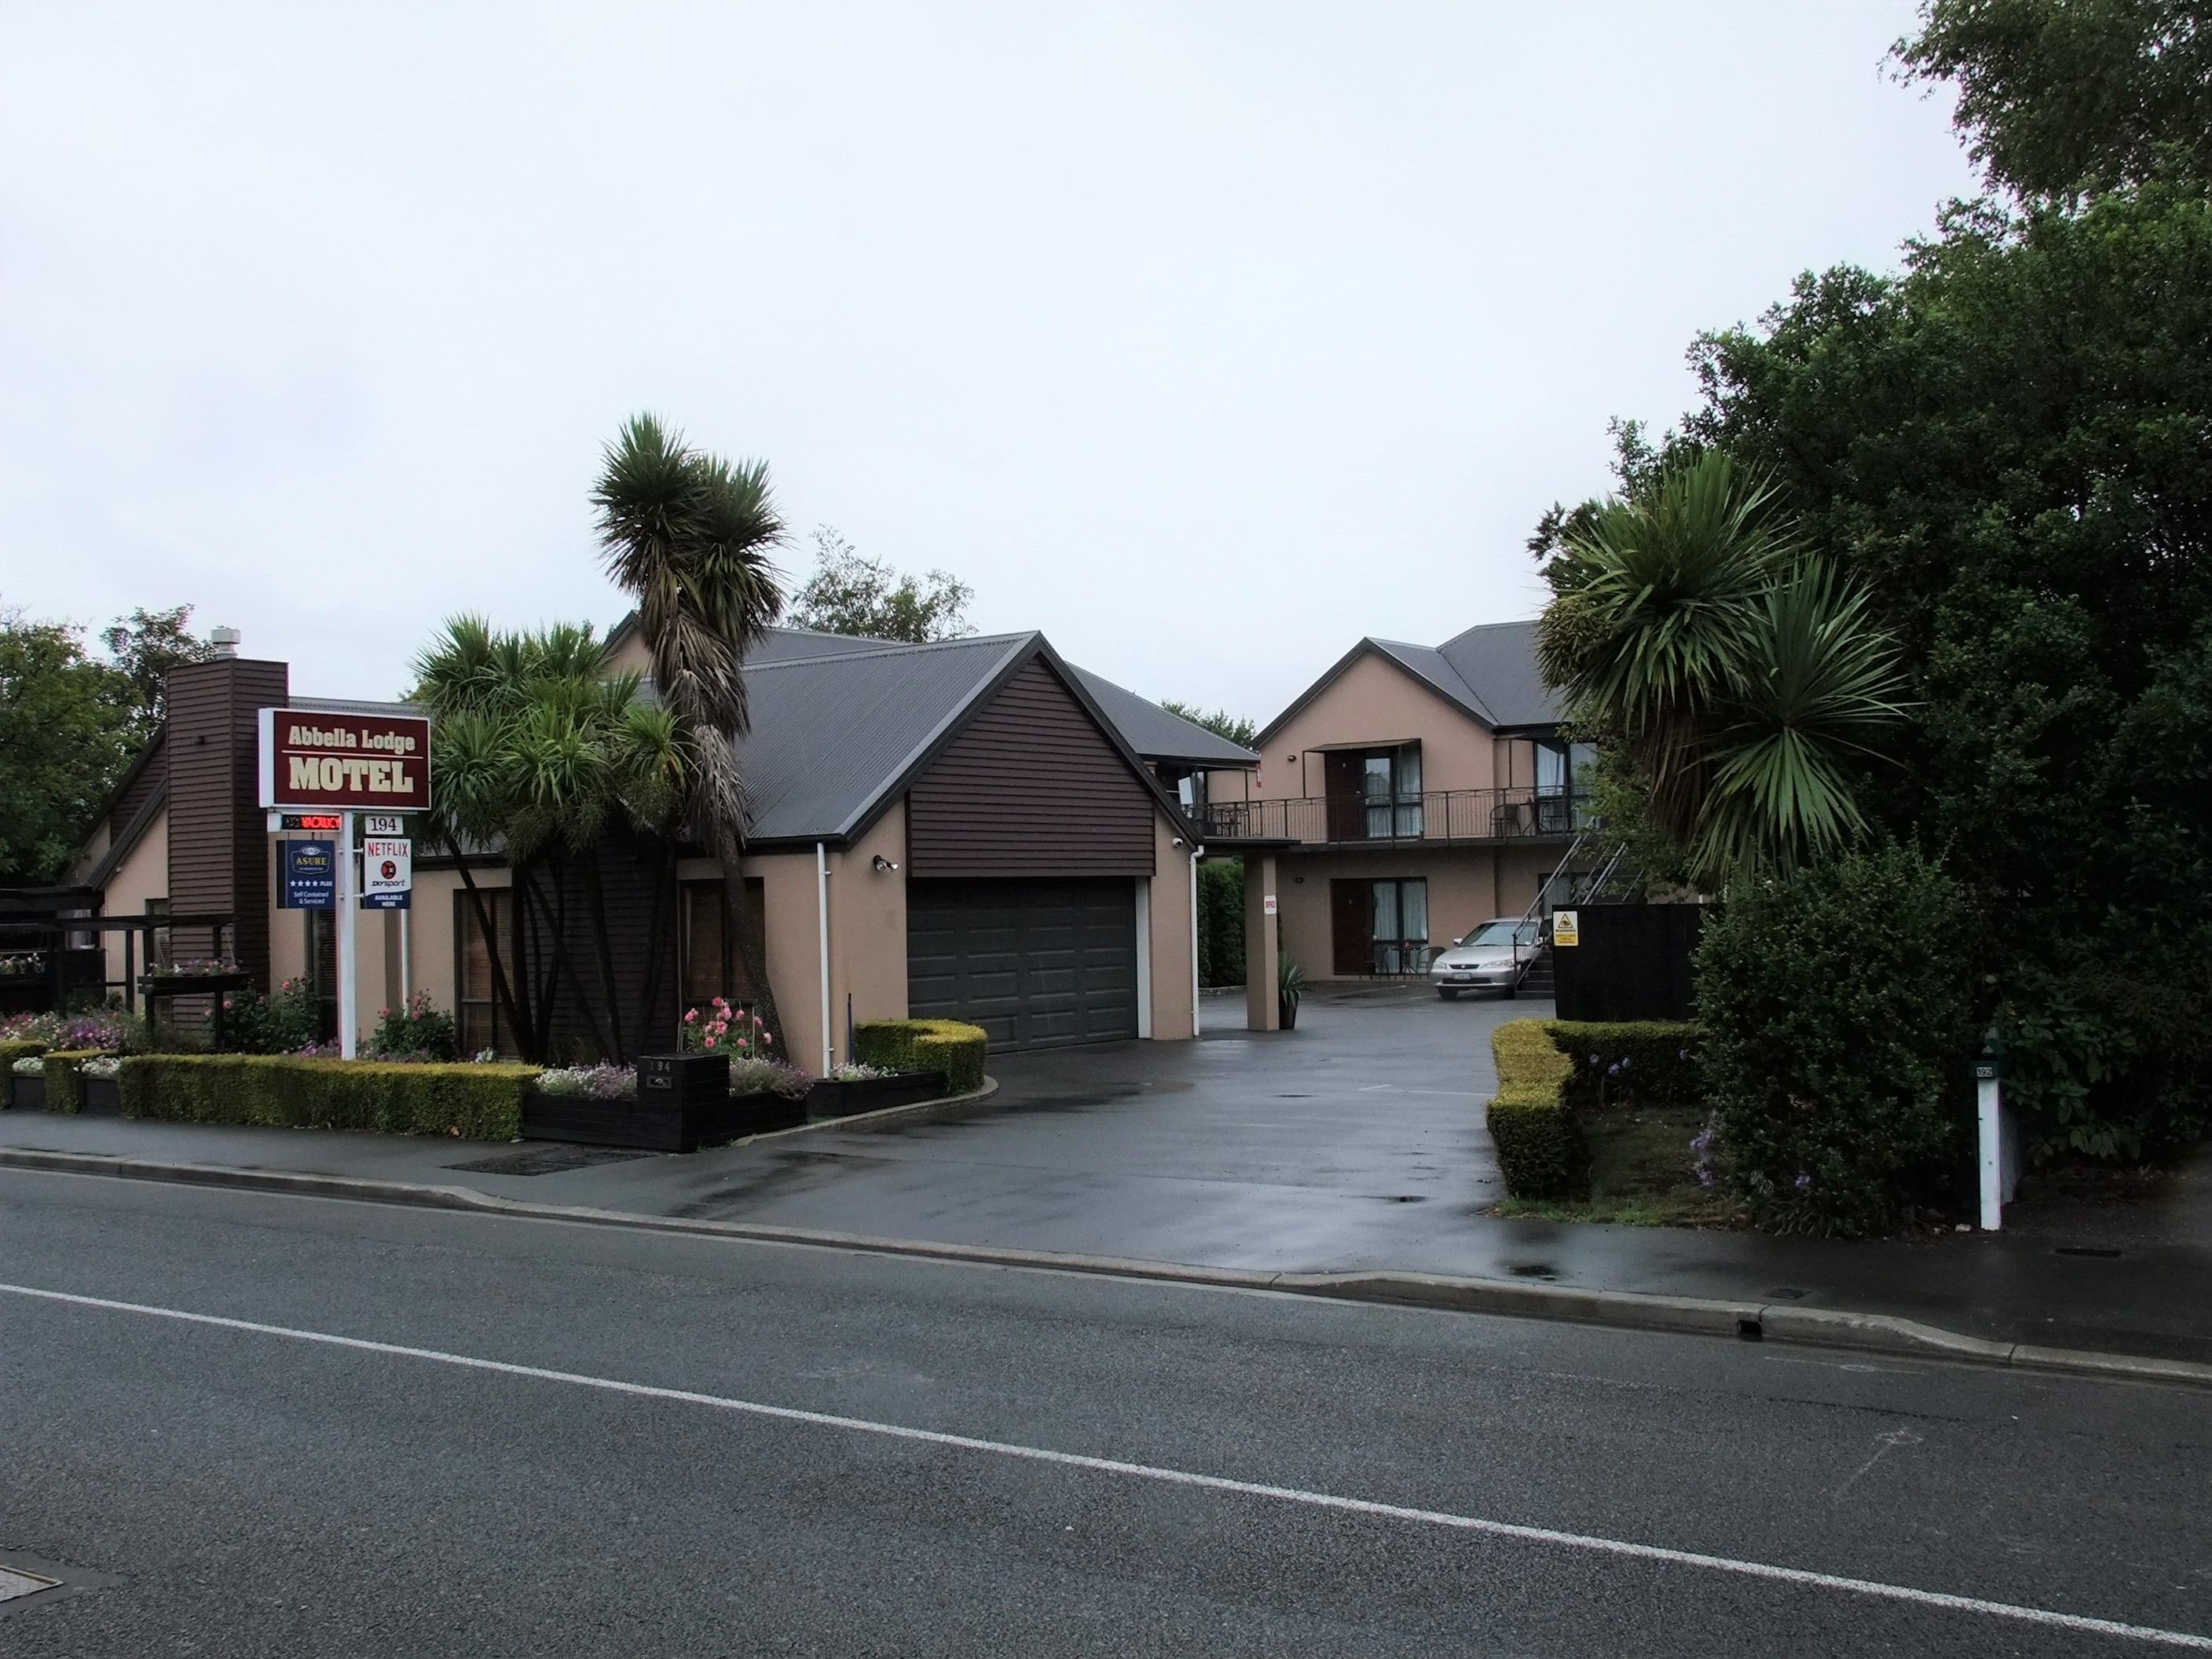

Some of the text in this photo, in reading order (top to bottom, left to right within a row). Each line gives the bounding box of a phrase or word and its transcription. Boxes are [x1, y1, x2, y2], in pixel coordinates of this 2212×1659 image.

[289, 726, 416, 755] Abbella Lodge
[288, 756, 414, 793] MOTEL
[370, 818, 397, 831] 194
[368, 842, 408, 858] NETFLIX
[650, 1061, 670, 1071] 194
